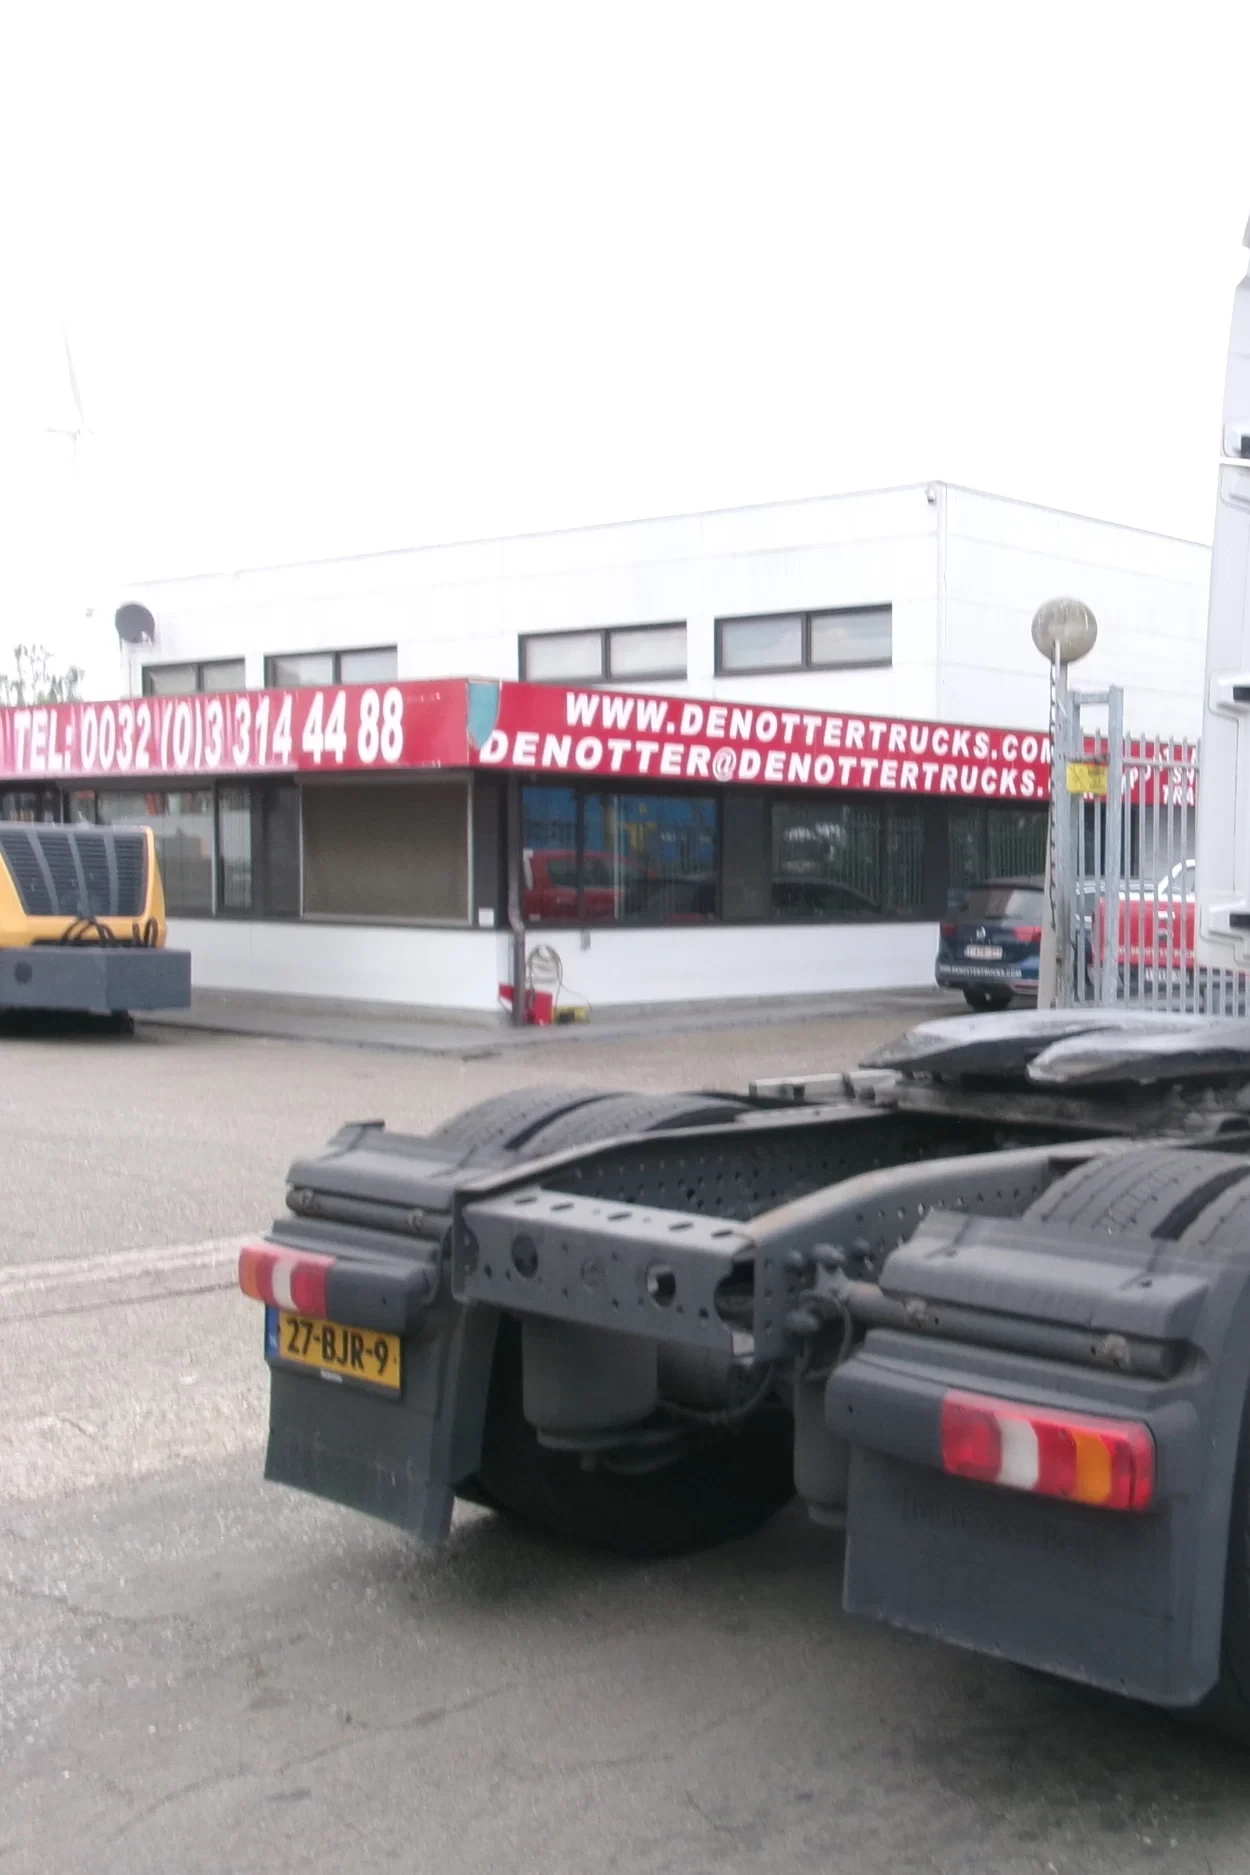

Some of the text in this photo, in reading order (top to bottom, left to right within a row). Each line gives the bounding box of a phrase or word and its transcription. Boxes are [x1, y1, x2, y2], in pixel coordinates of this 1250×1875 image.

[14, 686, 404, 773] TEL: 0032 (0)3 314 44 88
[287, 1317, 389, 1376] 27-BJR-9
